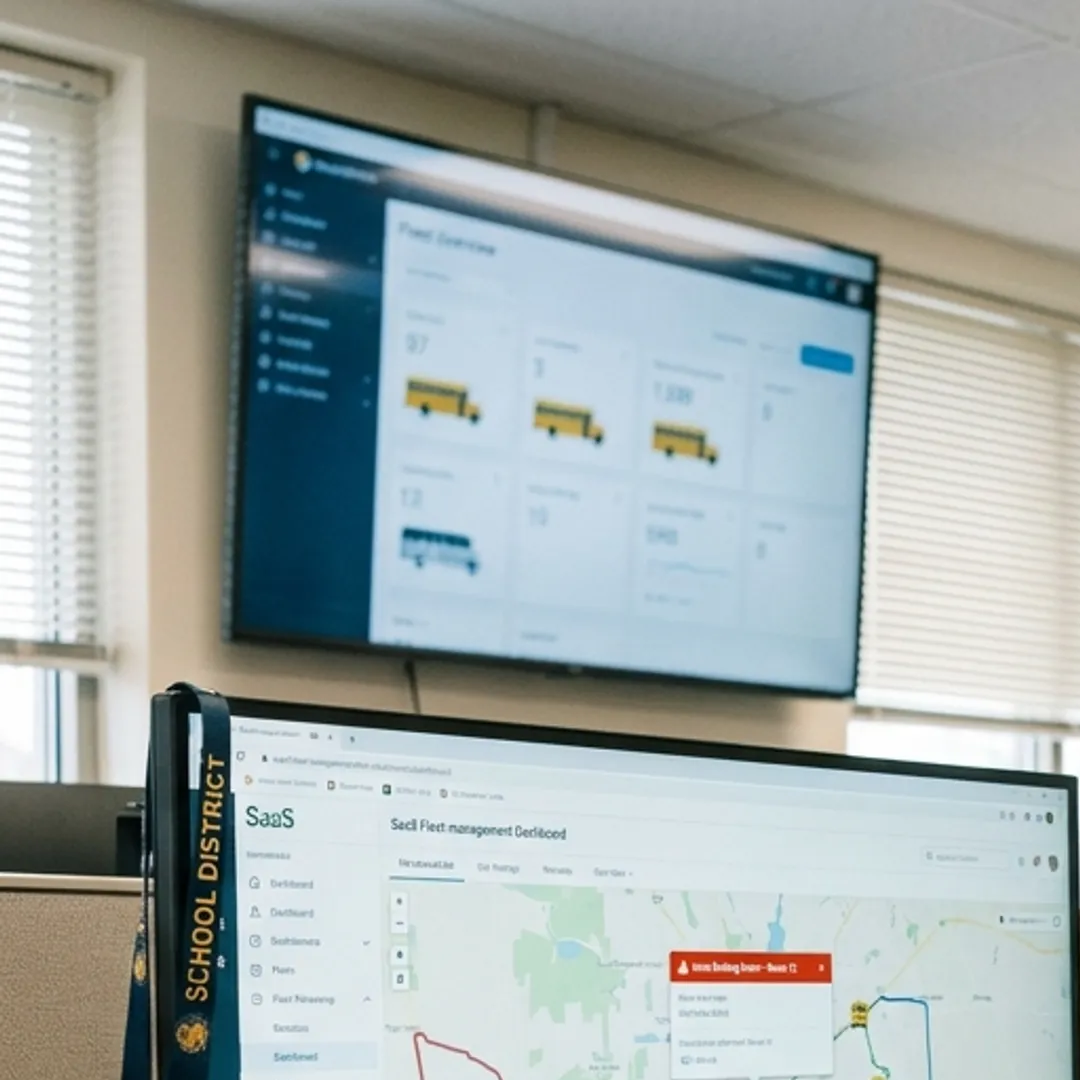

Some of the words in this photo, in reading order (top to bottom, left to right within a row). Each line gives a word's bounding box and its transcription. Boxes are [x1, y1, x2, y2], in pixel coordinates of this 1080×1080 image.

[197, 755, 225, 882] DISTRICT
[246, 805, 295, 829] SaaS
[186, 891, 217, 1002] SCHOOL
